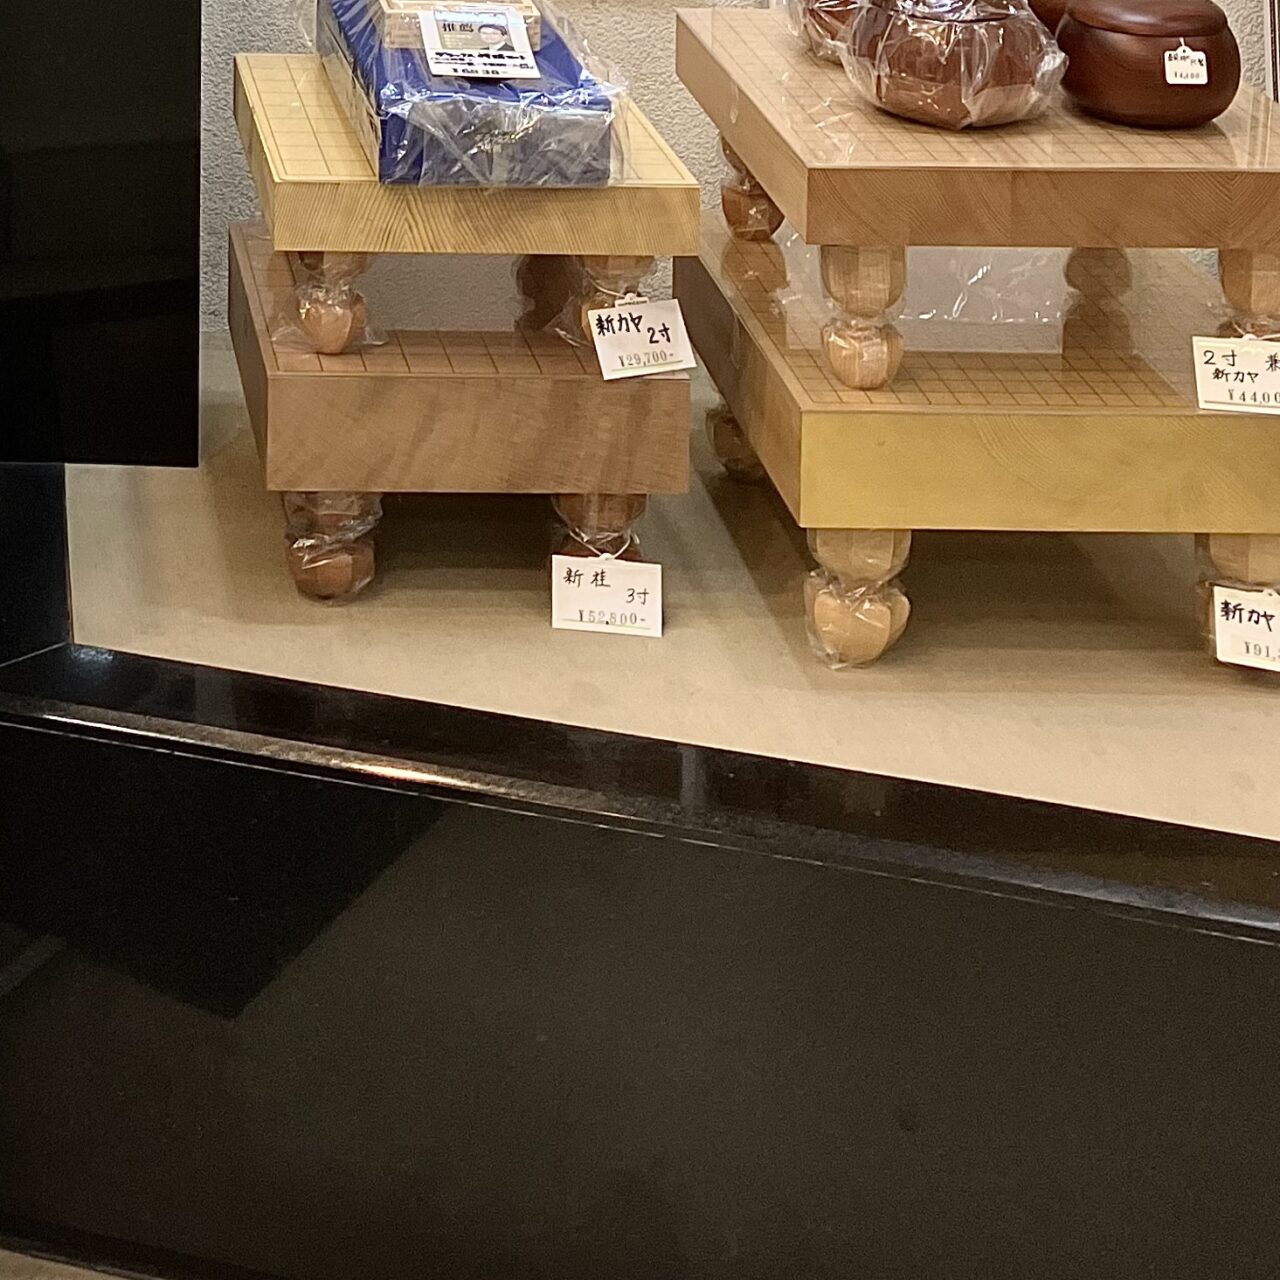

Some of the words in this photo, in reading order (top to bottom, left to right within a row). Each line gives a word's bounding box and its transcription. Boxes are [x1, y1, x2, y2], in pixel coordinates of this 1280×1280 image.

[595, 312, 643, 337] 新カヤ
[647, 322, 671, 344] 2寸
[1203, 349, 1238, 367] 2寸
[1212, 368, 1259, 383] 新カヤ
[625, 588, 650, 605] 3寸
[1220, 600, 1276, 632] 新カヤ
